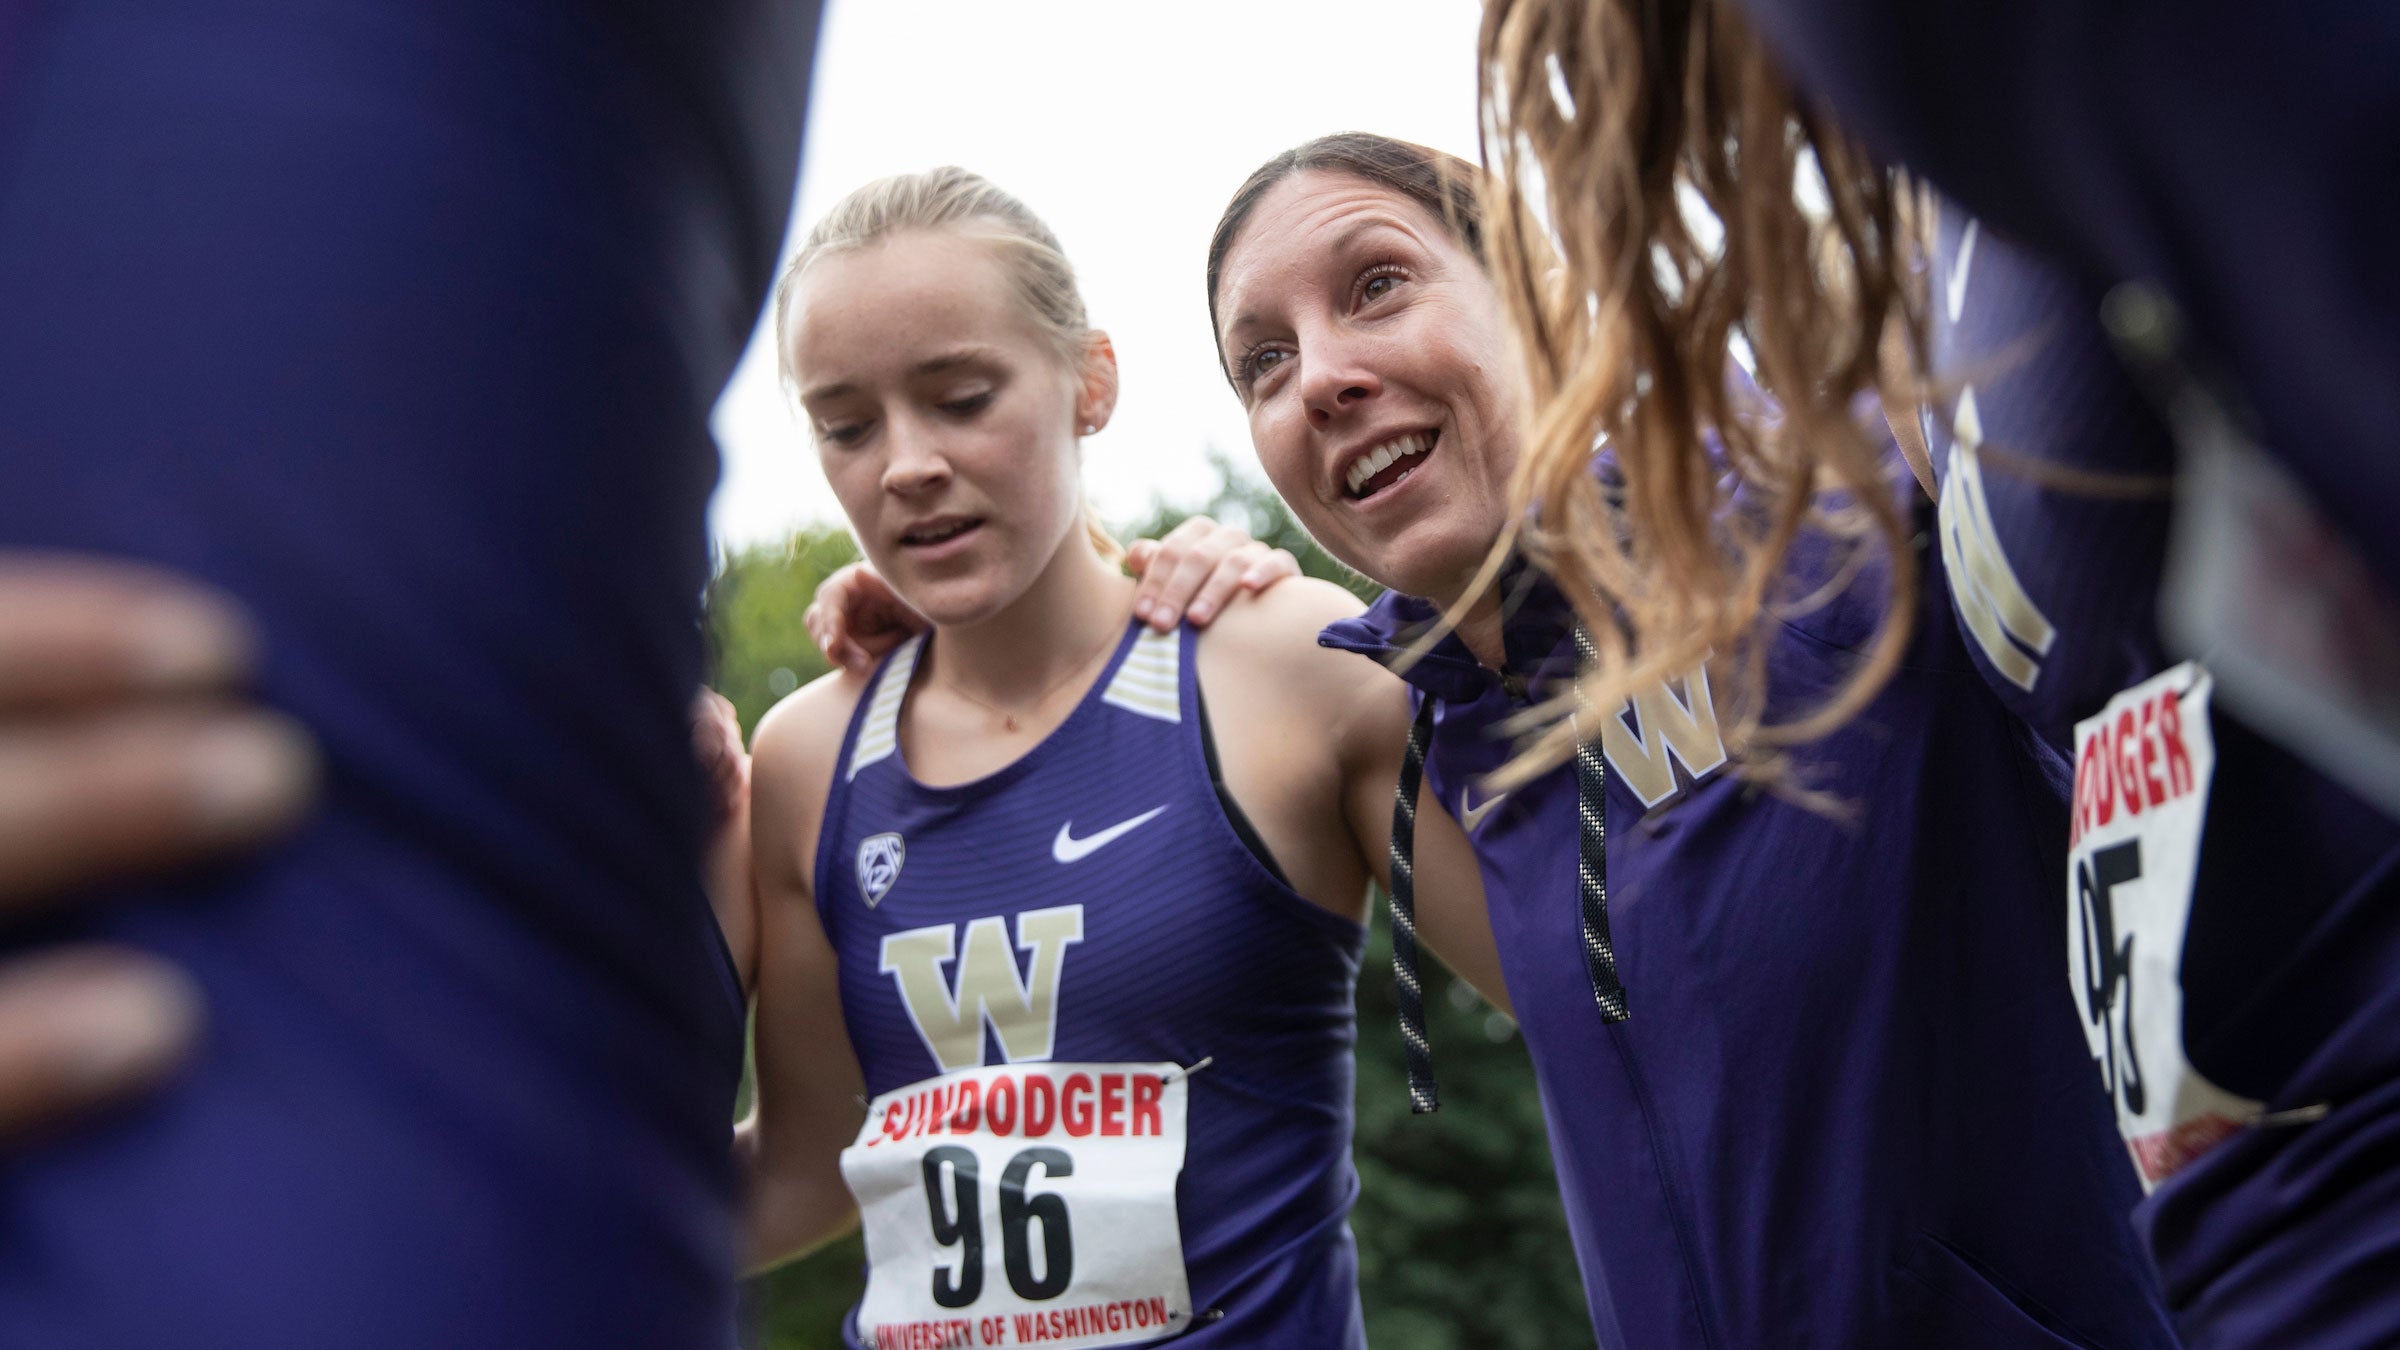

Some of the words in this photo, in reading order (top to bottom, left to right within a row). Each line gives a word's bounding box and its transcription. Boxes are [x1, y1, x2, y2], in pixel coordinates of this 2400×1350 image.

[1569, 645, 1727, 809] W
[878, 903, 1085, 1076] W
[868, 1073, 1164, 1147] SUNDODGER
[922, 1144, 1073, 1308] 96
[875, 1318, 973, 1350] UNIVERSITY
[980, 1316, 1005, 1346] OF
[1013, 1297, 1168, 1344] WASHINGTON
